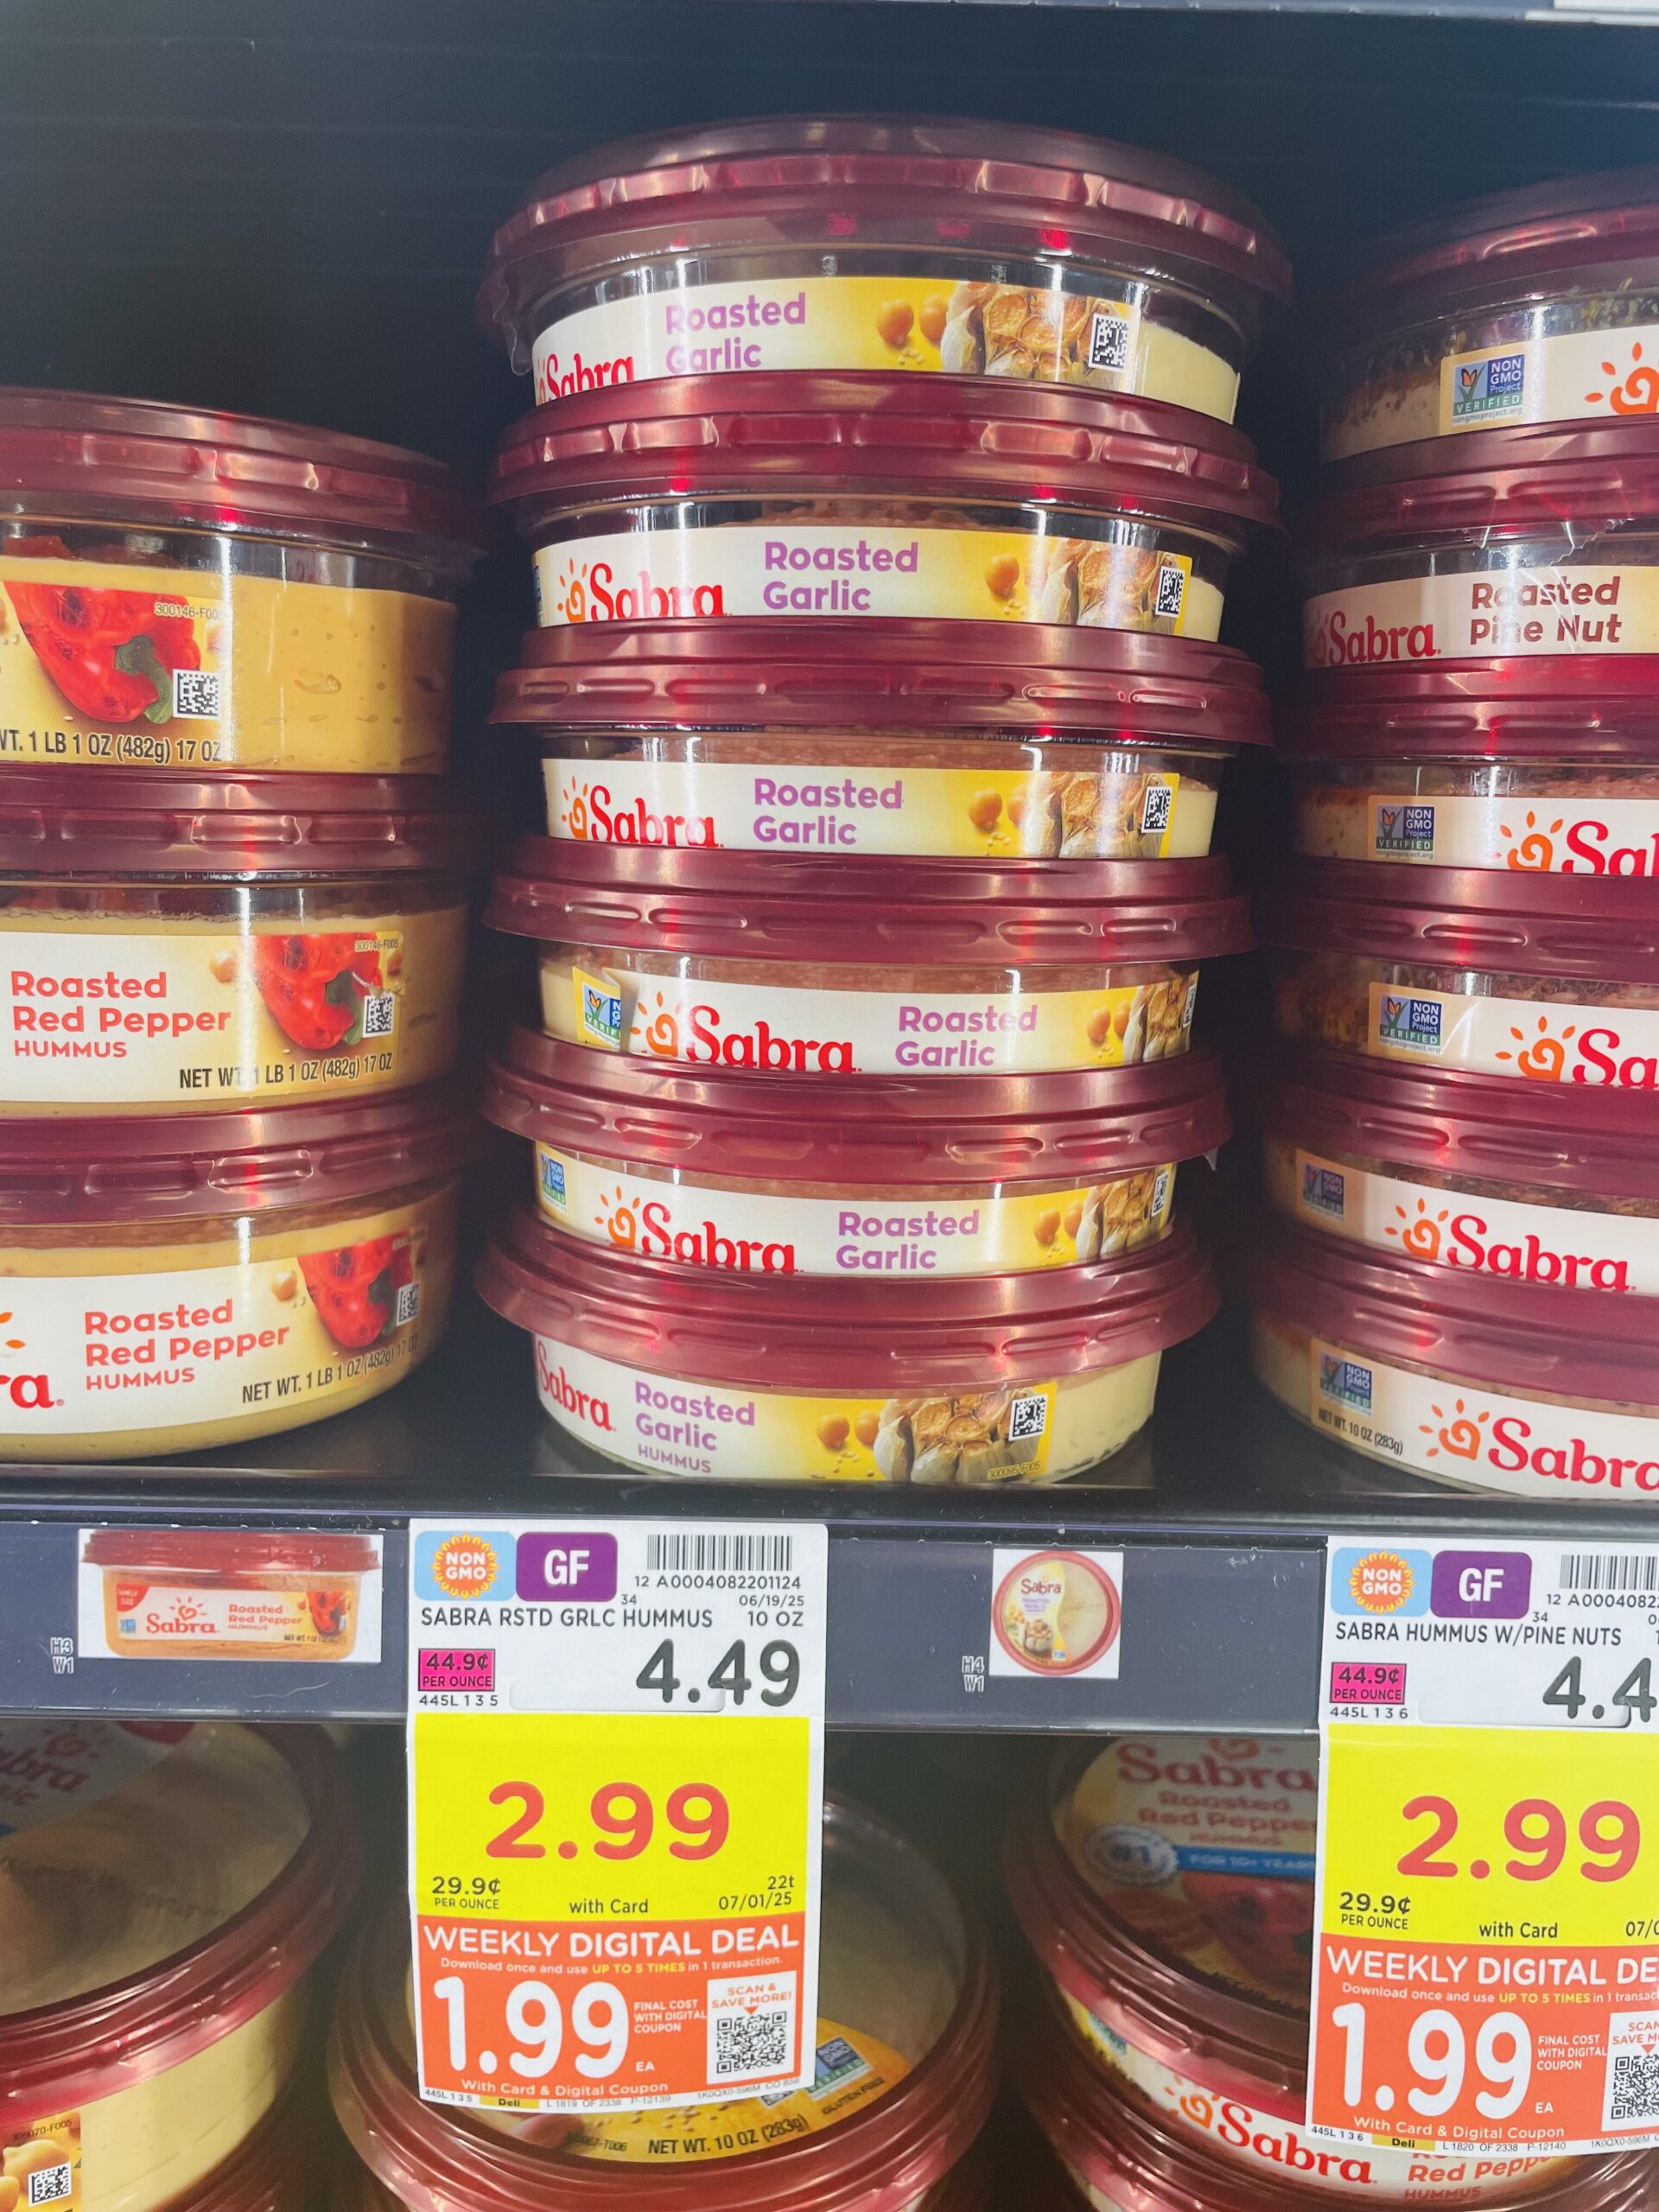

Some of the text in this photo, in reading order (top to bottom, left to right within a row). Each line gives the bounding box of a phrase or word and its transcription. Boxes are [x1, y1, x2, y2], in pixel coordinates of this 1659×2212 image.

[666, 291, 805, 335] Roasted
[665, 336, 761, 374] Garlic
[1491, 359, 1521, 373] NON
[1491, 370, 1522, 385] GMO
[1491, 383, 1522, 395] Project
[1456, 394, 1521, 414] VERIFIED
[765, 541, 918, 575] Roasted
[590, 563, 722, 620] Sabra
[763, 580, 871, 613] Garlic
[1471, 576, 1620, 610] Roasted
[1328, 610, 1438, 665] Sabra
[1557, 613, 1622, 644] Nut
[45, 731, 195, 764] LB OZ (482g) 17
[754, 779, 903, 810] Roasted
[589, 785, 717, 849] Sabra
[1406, 809, 1432, 819] NON
[1406, 819, 1432, 830] GMO
[753, 816, 857, 846] Garlic
[1378, 839, 1431, 850] VERIFIED
[11, 971, 167, 999] Roasted
[899, 1004, 1038, 1033] Roasted
[1413, 1002, 1439, 1015] NON
[13, 1006, 232, 1038] Red Pepper
[1412, 1013, 1439, 1026] GMO
[688, 1004, 855, 1073] Sabra
[1382, 1027, 1439, 1046] VERIFIED
[14, 1040, 127, 1058] HUMMUS
[895, 1041, 995, 1068] Garlic
[180, 1055, 360, 1089] NET LB OZ (482g)
[838, 1210, 979, 1237] Roasted
[642, 1202, 796, 1276] Sabra
[836, 1243, 937, 1270] Garlic
[1446, 1214, 1630, 1292] Sabra
[85, 1299, 232, 1334] Roasted
[86, 1326, 289, 1366] Red Pepper
[86, 1367, 195, 1390] HUMMUS
[243, 1370, 334, 1403] NET WT. LB
[635, 1380, 756, 1427] Roasted
[635, 1414, 717, 1452] Garlic
[638, 1446, 711, 1474] HUMMUS
[445, 1552, 486, 1566] NON
[543, 1549, 589, 1586] GF
[445, 1567, 486, 1580] GMO
[635, 1575, 802, 1590] 12 A0004082201124
[1363, 1568, 1402, 1581] NON
[1020, 1579, 1062, 1595] Sabra
[1362, 1582, 1402, 1596] GMO
[1459, 1567, 1504, 1602] GF
[228, 1604, 283, 1614] Roasted
[621, 1594, 637, 1605] 34
[739, 1594, 804, 1608] 06/19/25
[146, 1613, 216, 1634] Sabra
[259, 1615, 302, 1627] Pepper
[421, 1606, 713, 1628] SABRA RSTD GRLC HUMMUS
[747, 1611, 804, 1627] 10 OZ
[1533, 1611, 1548, 1623] 34
[1336, 1622, 1621, 1647] SABRA HUMMUS W/PINE NUTS
[426, 1652, 490, 1672] 44.9¢
[635, 1637, 801, 1707] 4.49
[423, 1675, 493, 1688] PER OUNCE
[1338, 1666, 1399, 1685] 44.9¢
[486, 1780, 730, 1861] 2.99
[1397, 1795, 1641, 1883] 2.99
[432, 1875, 501, 1896] 29.9¢
[434, 1897, 499, 1910] PER OUNCE
[569, 1897, 649, 1915] with Card
[718, 1891, 792, 1912] 07/01/25
[1339, 1891, 1411, 1915] 29.9¢
[423, 1923, 800, 1958] WEEKLY DIGITAL DEAL
[1519, 1922, 1558, 1938] Card
[441, 1956, 783, 1974] Download once and use UP TO TIMES transaction.
[1326, 1945, 1606, 1986] WEEKLY DIGITAL
[711, 1991, 791, 2009] SAVE MORE!
[728, 1983, 764, 1996] SCAN
[1342, 1982, 1591, 2004] Download TIMES
[634, 1999, 698, 2012] FINAL COST
[634, 2009, 707, 2023] WITH DIGITAL
[433, 1975, 629, 2079] 1.99
[634, 2023, 682, 2033] COUPON
[1612, 2033, 1643, 2045] SAVE
[1332, 2002, 1532, 2120] 1.99
[1567, 2046, 1608, 2057] DIGITAL
[635, 2061, 655, 2073] EA
[1536, 2060, 1582, 2070] COUPON
[461, 2079, 669, 2099] With Card Digital Coupon
[498, 2097, 520, 2107] Deli
[1353, 2115, 1565, 2143] With Card Digital Coupon
[649, 2137, 711, 2154] NET WT.
[1217, 2101, 1372, 2184] Sabra
[1391, 2138, 1415, 2150] Deli
[1496, 2141, 1567, 2152] 2338 P-12140
[1408, 2162, 1472, 2183] Red
